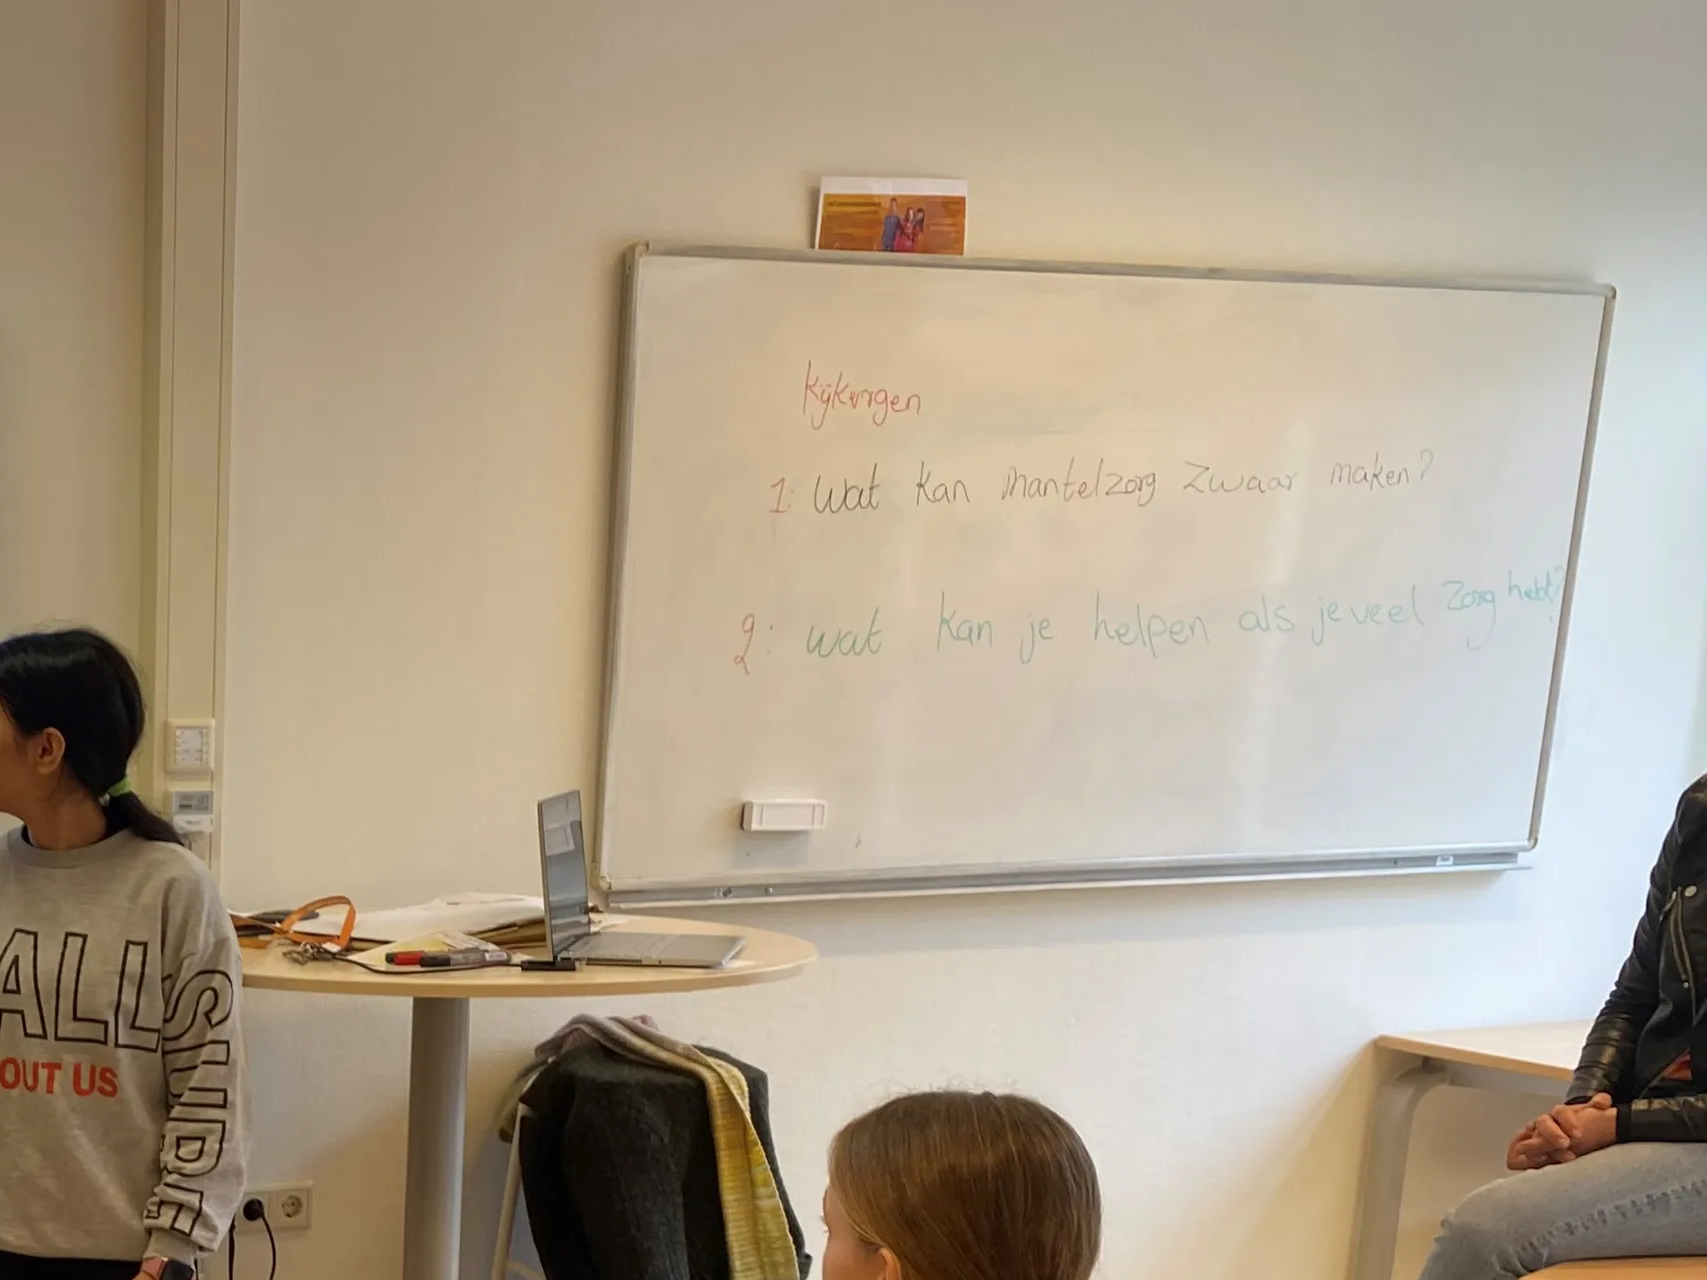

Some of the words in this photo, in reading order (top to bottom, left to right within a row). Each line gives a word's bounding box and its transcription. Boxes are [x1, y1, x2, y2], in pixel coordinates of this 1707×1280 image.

[1019, 612, 1055, 665] je
[1094, 590, 1210, 658] helpen
[1237, 594, 1295, 634] als
[72, 1061, 118, 1099] US
